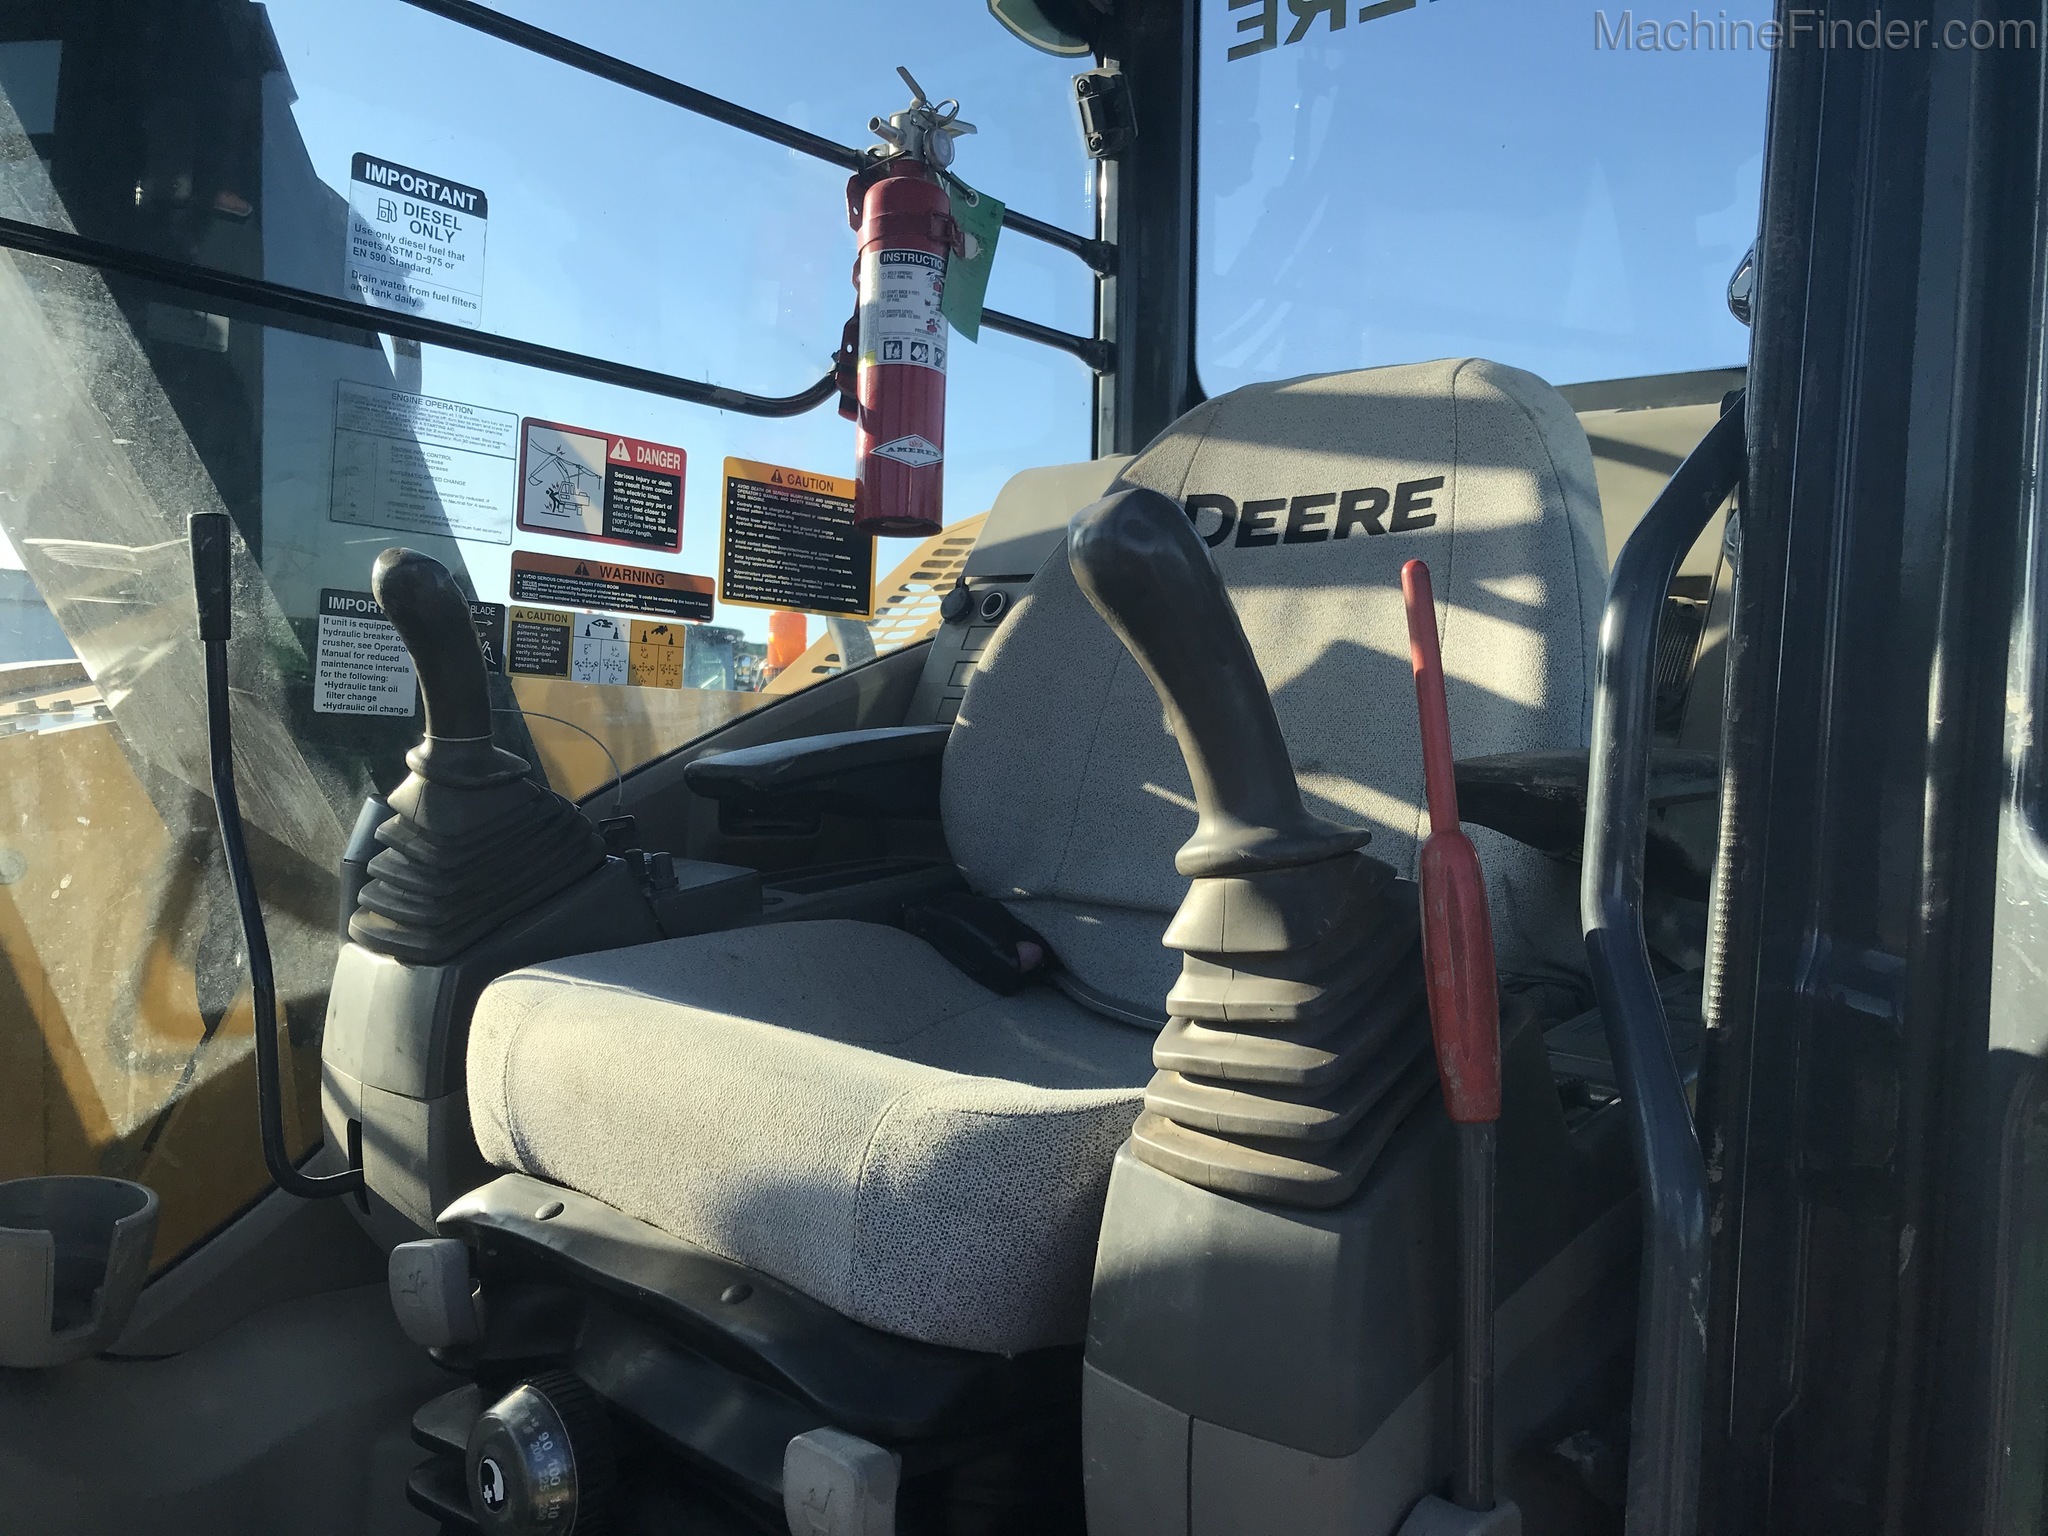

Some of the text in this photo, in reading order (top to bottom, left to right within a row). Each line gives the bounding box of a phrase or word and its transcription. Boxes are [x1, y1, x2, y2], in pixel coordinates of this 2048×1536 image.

[366, 162, 477, 211] IMPORTANT
[404, 202, 462, 231] DIESEL
[410, 220, 455, 244] ONLY
[354, 224, 465, 261] Use only diesel fuel that
[354, 236, 383, 251] meets
[386, 244, 413, 259] ASTM
[416, 252, 442, 267] D-975
[353, 247, 433, 275] EN 590 Standard.
[883, 253, 944, 270] INSTRUCTIO
[350, 282, 368, 294] and
[372, 287, 392, 300] tank
[352, 270, 477, 310] Drain water from fuel filters
[392, 393, 473, 415] ENGINE OPERATION
[637, 446, 680, 470] DANGER
[654, 487, 673, 495] contact
[788, 474, 833, 492] CAUTION
[626, 489, 647, 498] electric
[613, 495, 629, 503] Never
[645, 501, 654, 509] any
[656, 502, 666, 511] part
[1186, 476, 1445, 548] DEERE
[600, 566, 665, 586] WARNING
[471, 606, 496, 616] BLADE
[527, 611, 568, 623] CAUTION
[332, 618, 347, 626] unit
[323, 627, 361, 640] hydraulic
[364, 632, 393, 641] breaker
[323, 638, 356, 649] crusher,
[374, 643, 408, 654] Operato
[322, 648, 399, 662] Manual for reduced
[515, 655, 539, 663] response
[322, 658, 409, 673] maintenance intervals
[321, 669, 388, 684] for the following:
[369, 684, 386, 692] tank
[326, 691, 377, 704] filter change
[380, 706, 409, 716] change
[538, 1431, 554, 1451] 90
[548, 1458, 561, 1487] 100
